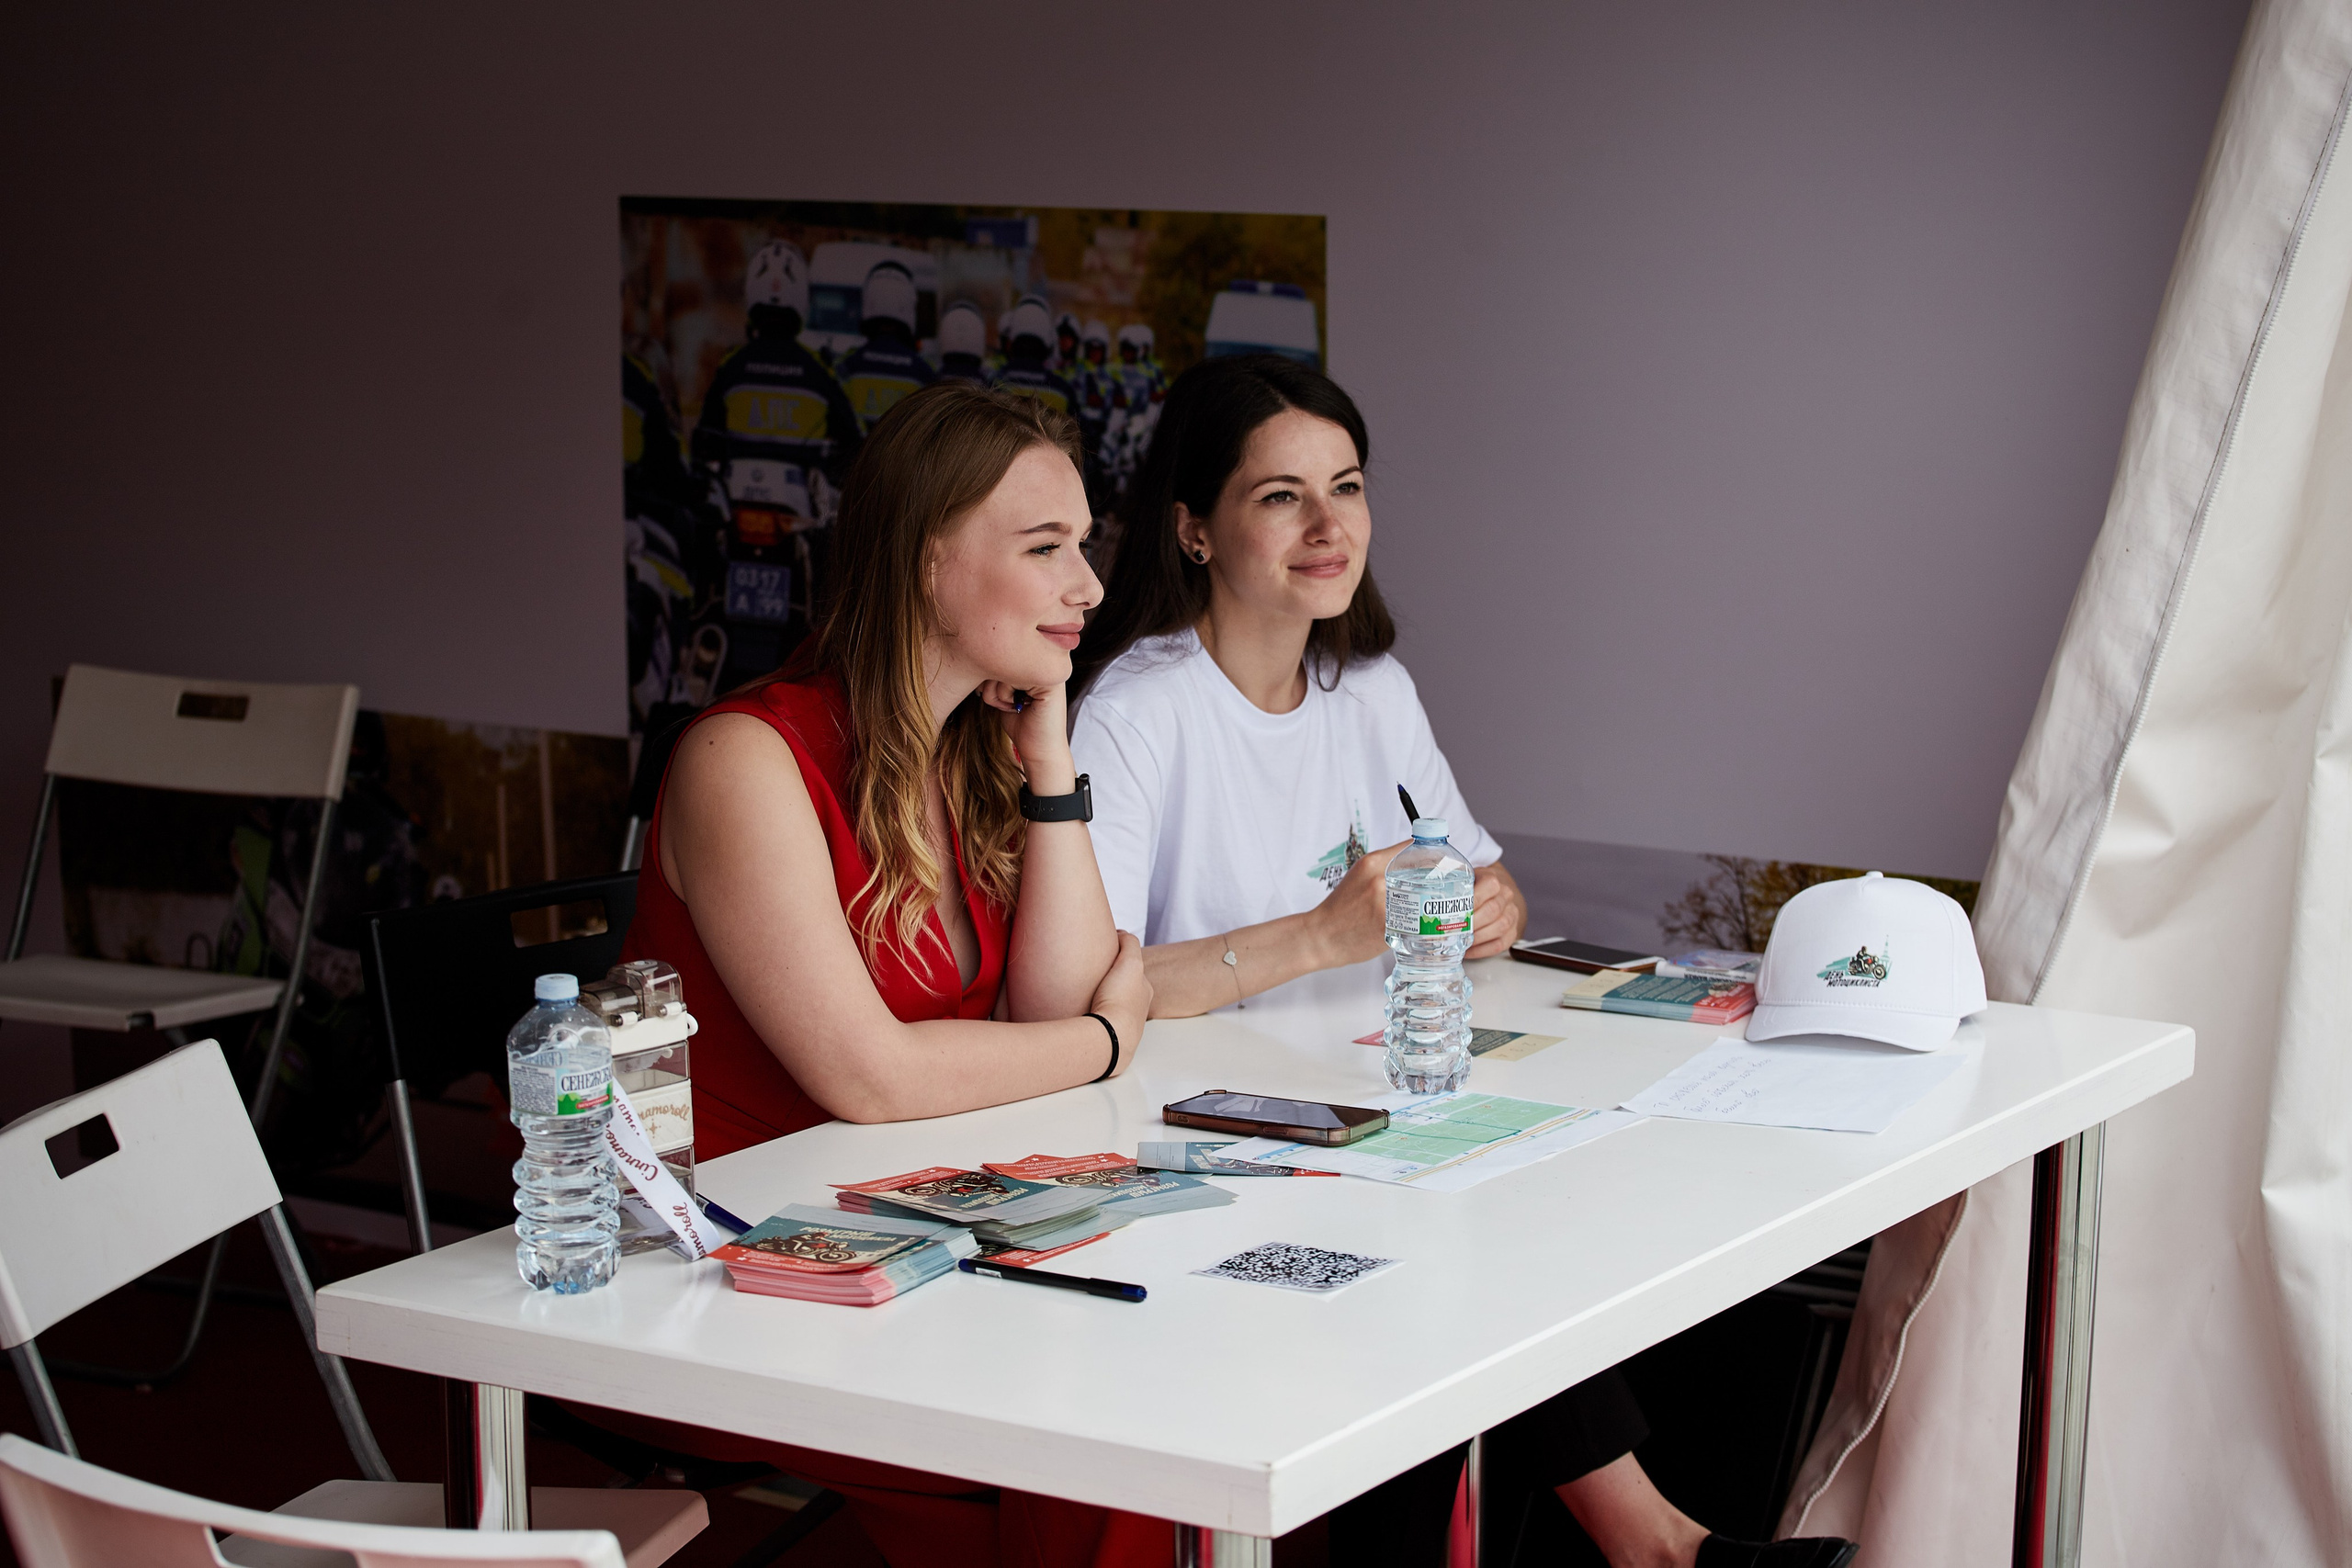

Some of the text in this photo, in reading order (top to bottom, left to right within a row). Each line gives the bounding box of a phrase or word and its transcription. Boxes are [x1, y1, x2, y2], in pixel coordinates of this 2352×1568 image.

[747, 396, 801, 431] ДПС
[1823, 970, 1845, 982] ДЕНЬ
[1826, 978, 1882, 988] МОТОЦИКЛИСТА
